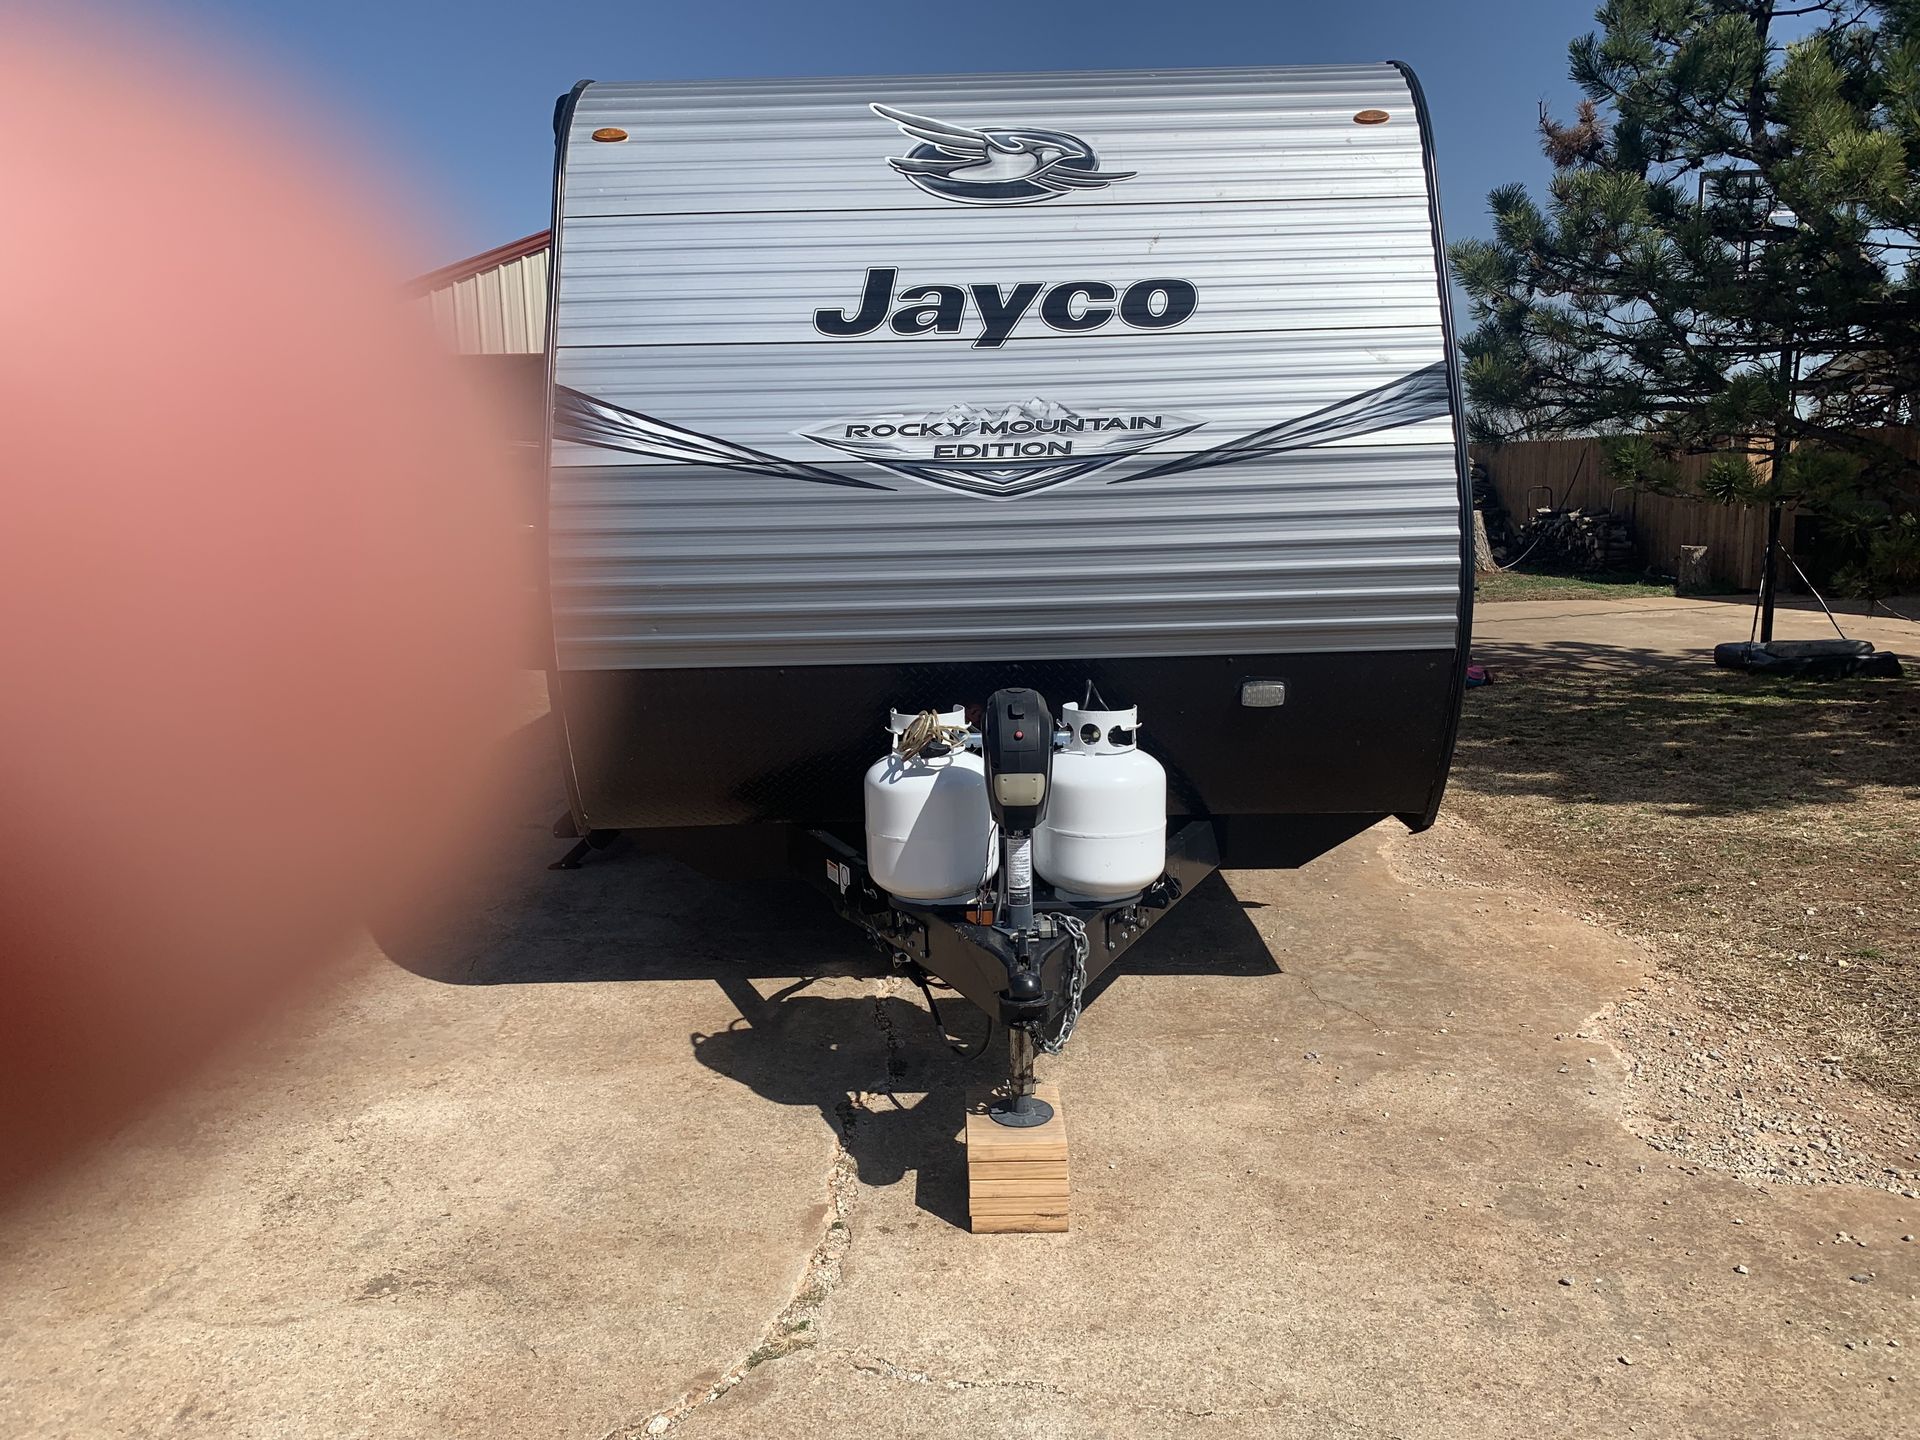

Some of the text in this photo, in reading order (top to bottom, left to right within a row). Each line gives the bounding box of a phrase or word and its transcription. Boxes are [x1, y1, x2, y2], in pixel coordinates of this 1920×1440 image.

[813, 266, 1198, 349] Jayco
[845, 416, 1163, 439] ROCKY MOUNTAIN
[933, 441, 1073, 459] EDITION
